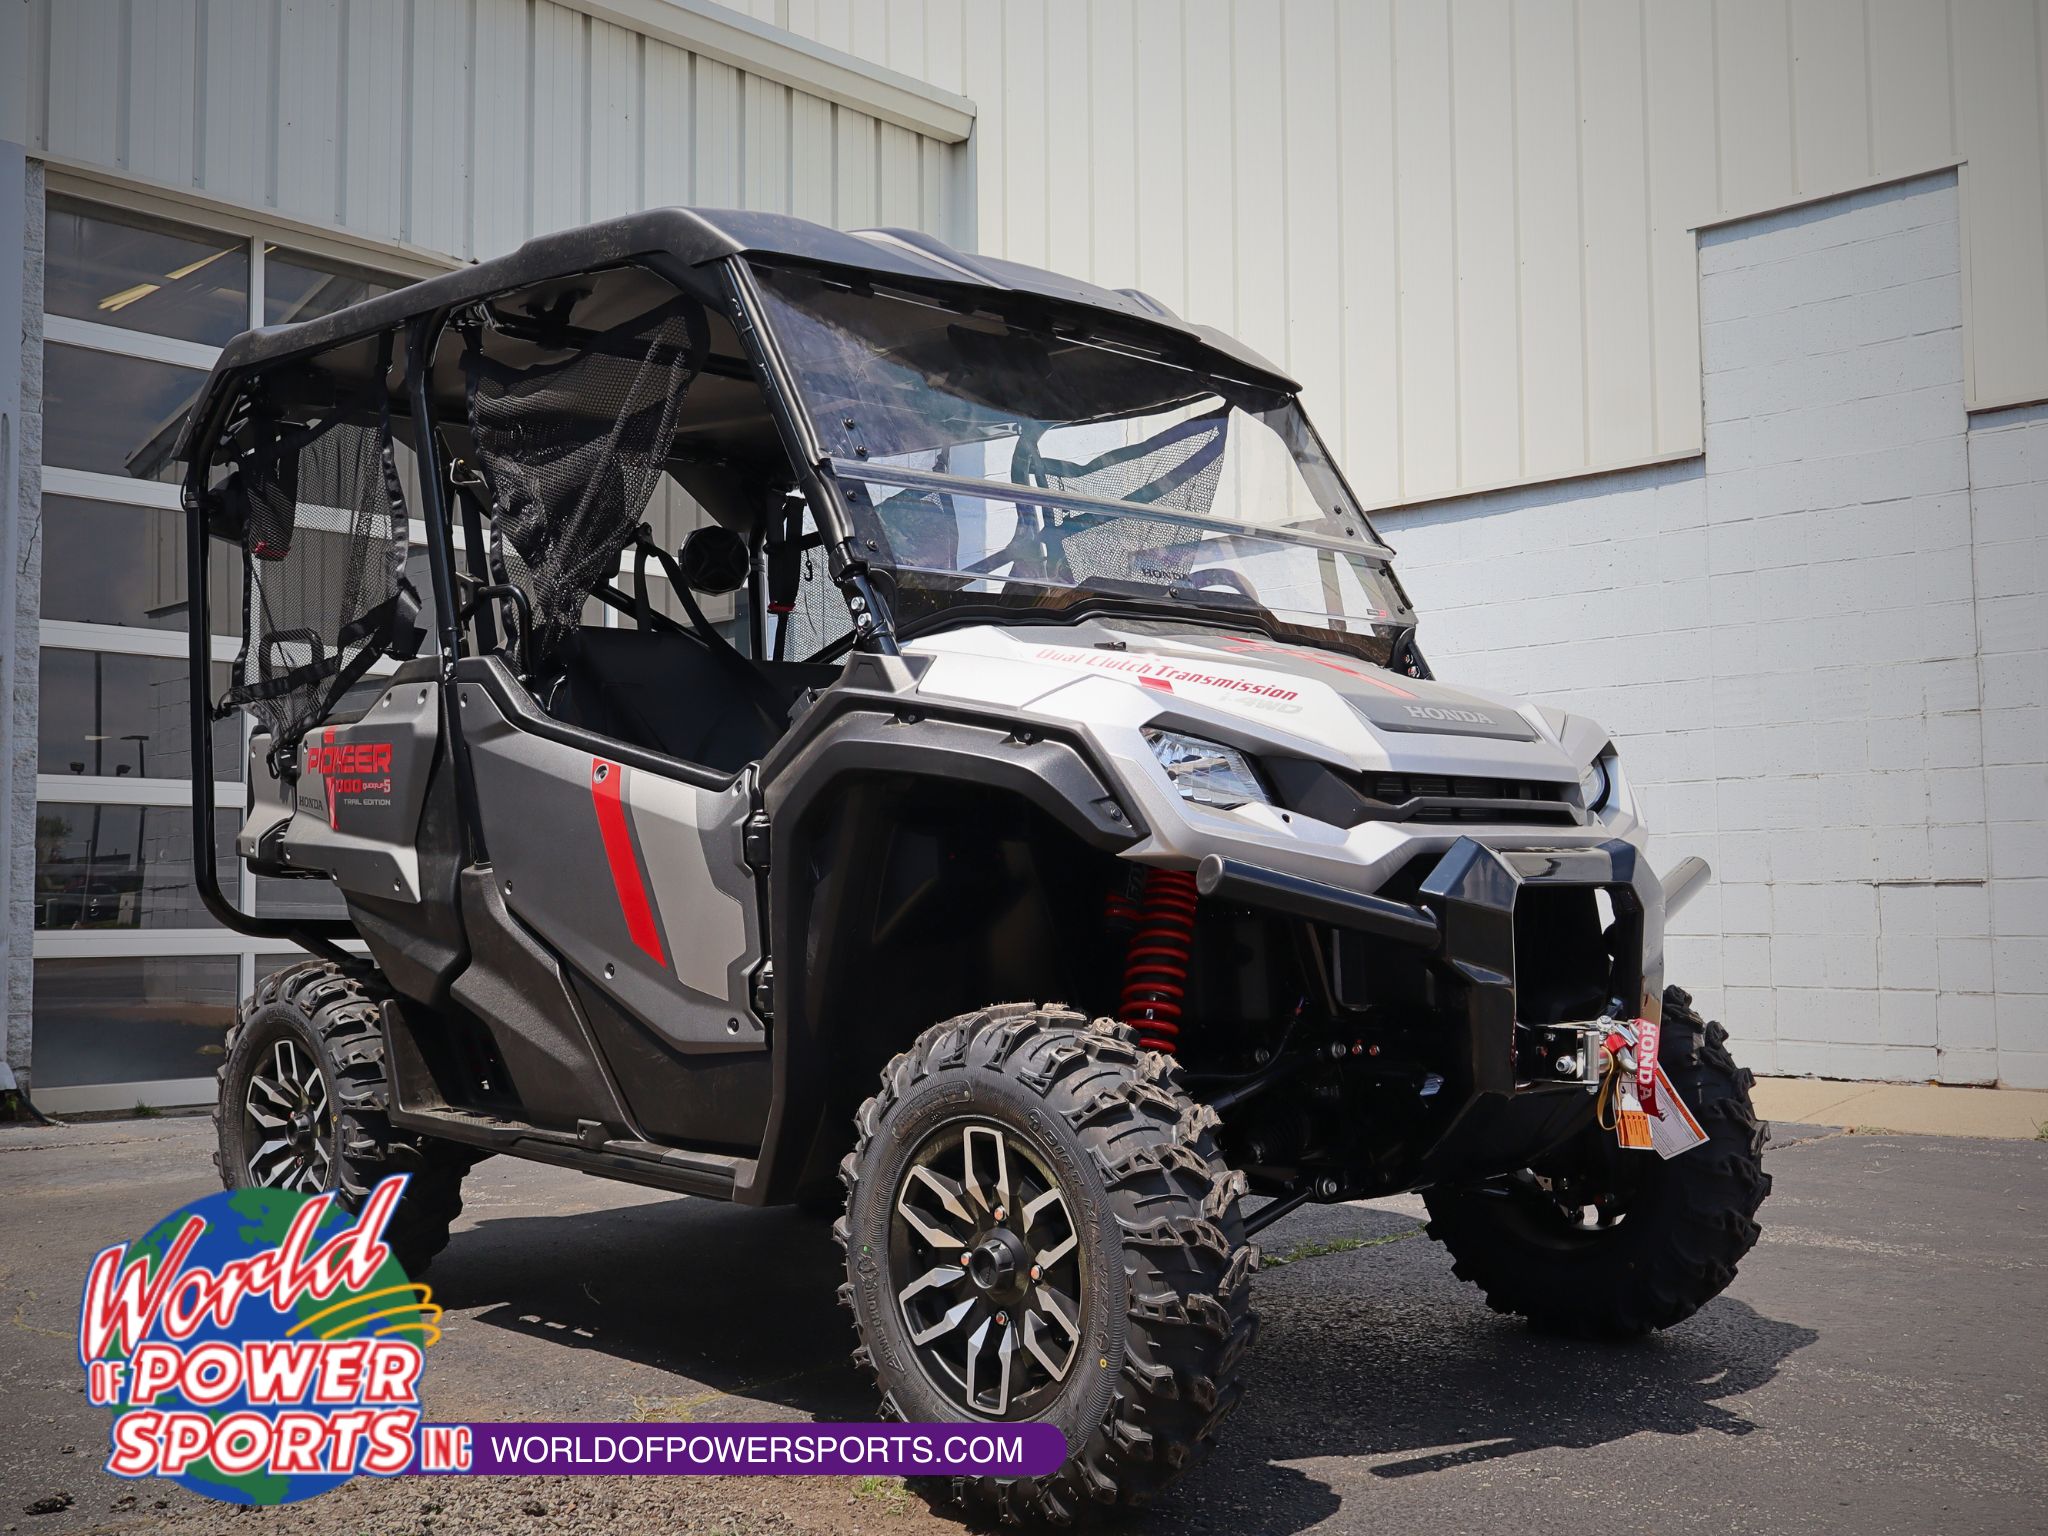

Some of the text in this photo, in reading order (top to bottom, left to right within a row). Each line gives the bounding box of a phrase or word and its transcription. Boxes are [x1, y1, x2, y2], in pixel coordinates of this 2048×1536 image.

[1035, 649, 1299, 701] Dual Clutch Transmission
[1403, 705, 1497, 725] HONDA
[308, 743, 392, 774] PIONEER
[299, 795, 324, 811] HONDA
[363, 798, 391, 806] EDITION
[1637, 1022, 1658, 1101] HONDA
